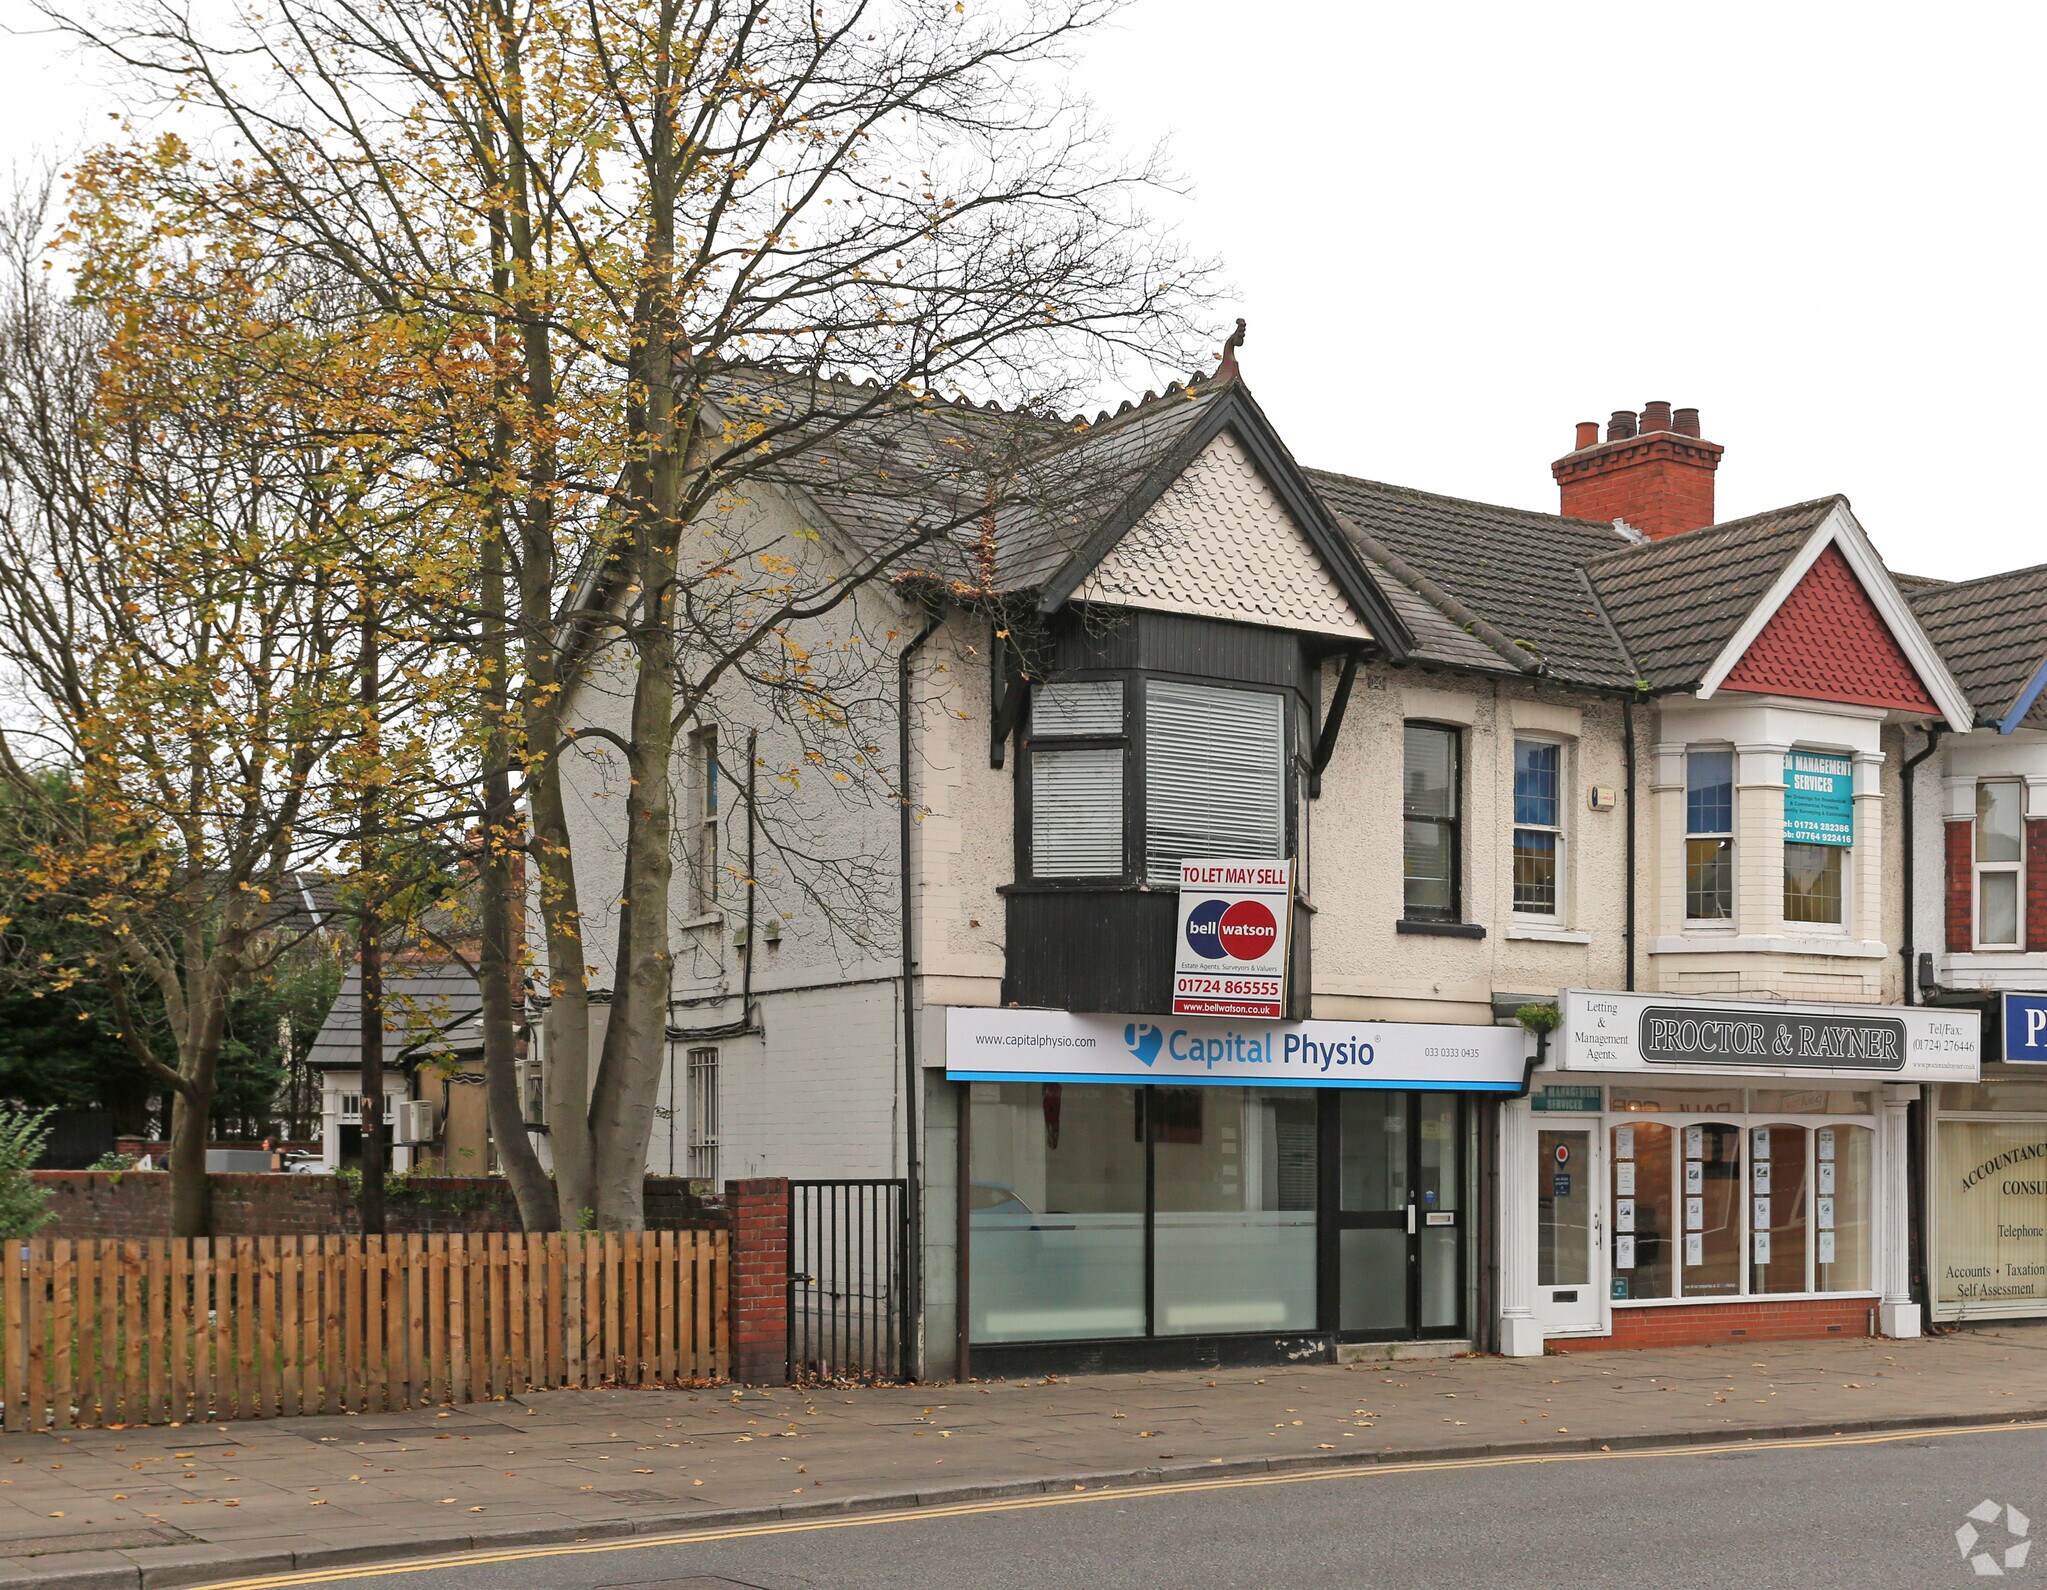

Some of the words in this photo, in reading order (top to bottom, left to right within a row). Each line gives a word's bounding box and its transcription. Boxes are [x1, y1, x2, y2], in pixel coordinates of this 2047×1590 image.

[1796, 756, 1852, 776] MANAGEMENT
[1794, 774, 1833, 792] SERVICES
[1784, 820, 1792, 828] el:
[1794, 820, 1818, 830] 01724
[1820, 822, 1850, 832] 282386
[1796, 831, 1820, 840] 07764
[1822, 834, 1851, 843] 922416
[1182, 867, 1200, 882] TO
[1202, 868, 1223, 883] LET
[1226, 868, 1255, 884] MAY
[1257, 869, 1286, 884] SELL
[1190, 920, 1216, 935] bell
[1222, 924, 1274, 937] watson
[1200, 963, 1220, 971] Agents,
[1222, 964, 1250, 972] Surveyors
[1178, 978, 1221, 993] 01724
[1224, 980, 1278, 996] 865555
[1183, 1002, 1270, 1014] www.bellwatson.co.uk
[1587, 1000, 1618, 1016] Letting
[1597, 1017, 1606, 1028] &
[1929, 1022, 1962, 1036] Tel/Fax:
[2025, 1008, 2047, 1048] P
[1575, 1032, 1628, 1046] Management
[1650, 1018, 1766, 1055] PROCTOR
[1772, 1024, 1794, 1056] &
[1798, 1025, 1898, 1060] RAYNER
[1912, 1039, 1941, 1052] (01724)
[1944, 1040, 1974, 1052] 276446
[976, 1034, 1096, 1049] www.capitalphysio.com
[1168, 1029, 1272, 1070] Capital
[1425, 1047, 1438, 1057] 033
[1441, 1048, 1459, 1058] 0333
[1461, 1048, 1479, 1058] 0435
[1586, 1048, 1617, 1062] Agents.
[1912, 1062, 1976, 1071] www.proctorandrayner.co.uk
[1547, 1087, 1599, 1098] MANAGEMENT
[1547, 1099, 1583, 1110] SERVICES
[2002, 1180, 2047, 1195] CONSU
[1998, 1224, 2044, 1240] Telephone
[1946, 1266, 1991, 1279] Accounts
[2006, 1262, 2045, 1276] Taxation
[1957, 1283, 1978, 1297] Self
[1980, 1282, 2034, 1296] Assessment
